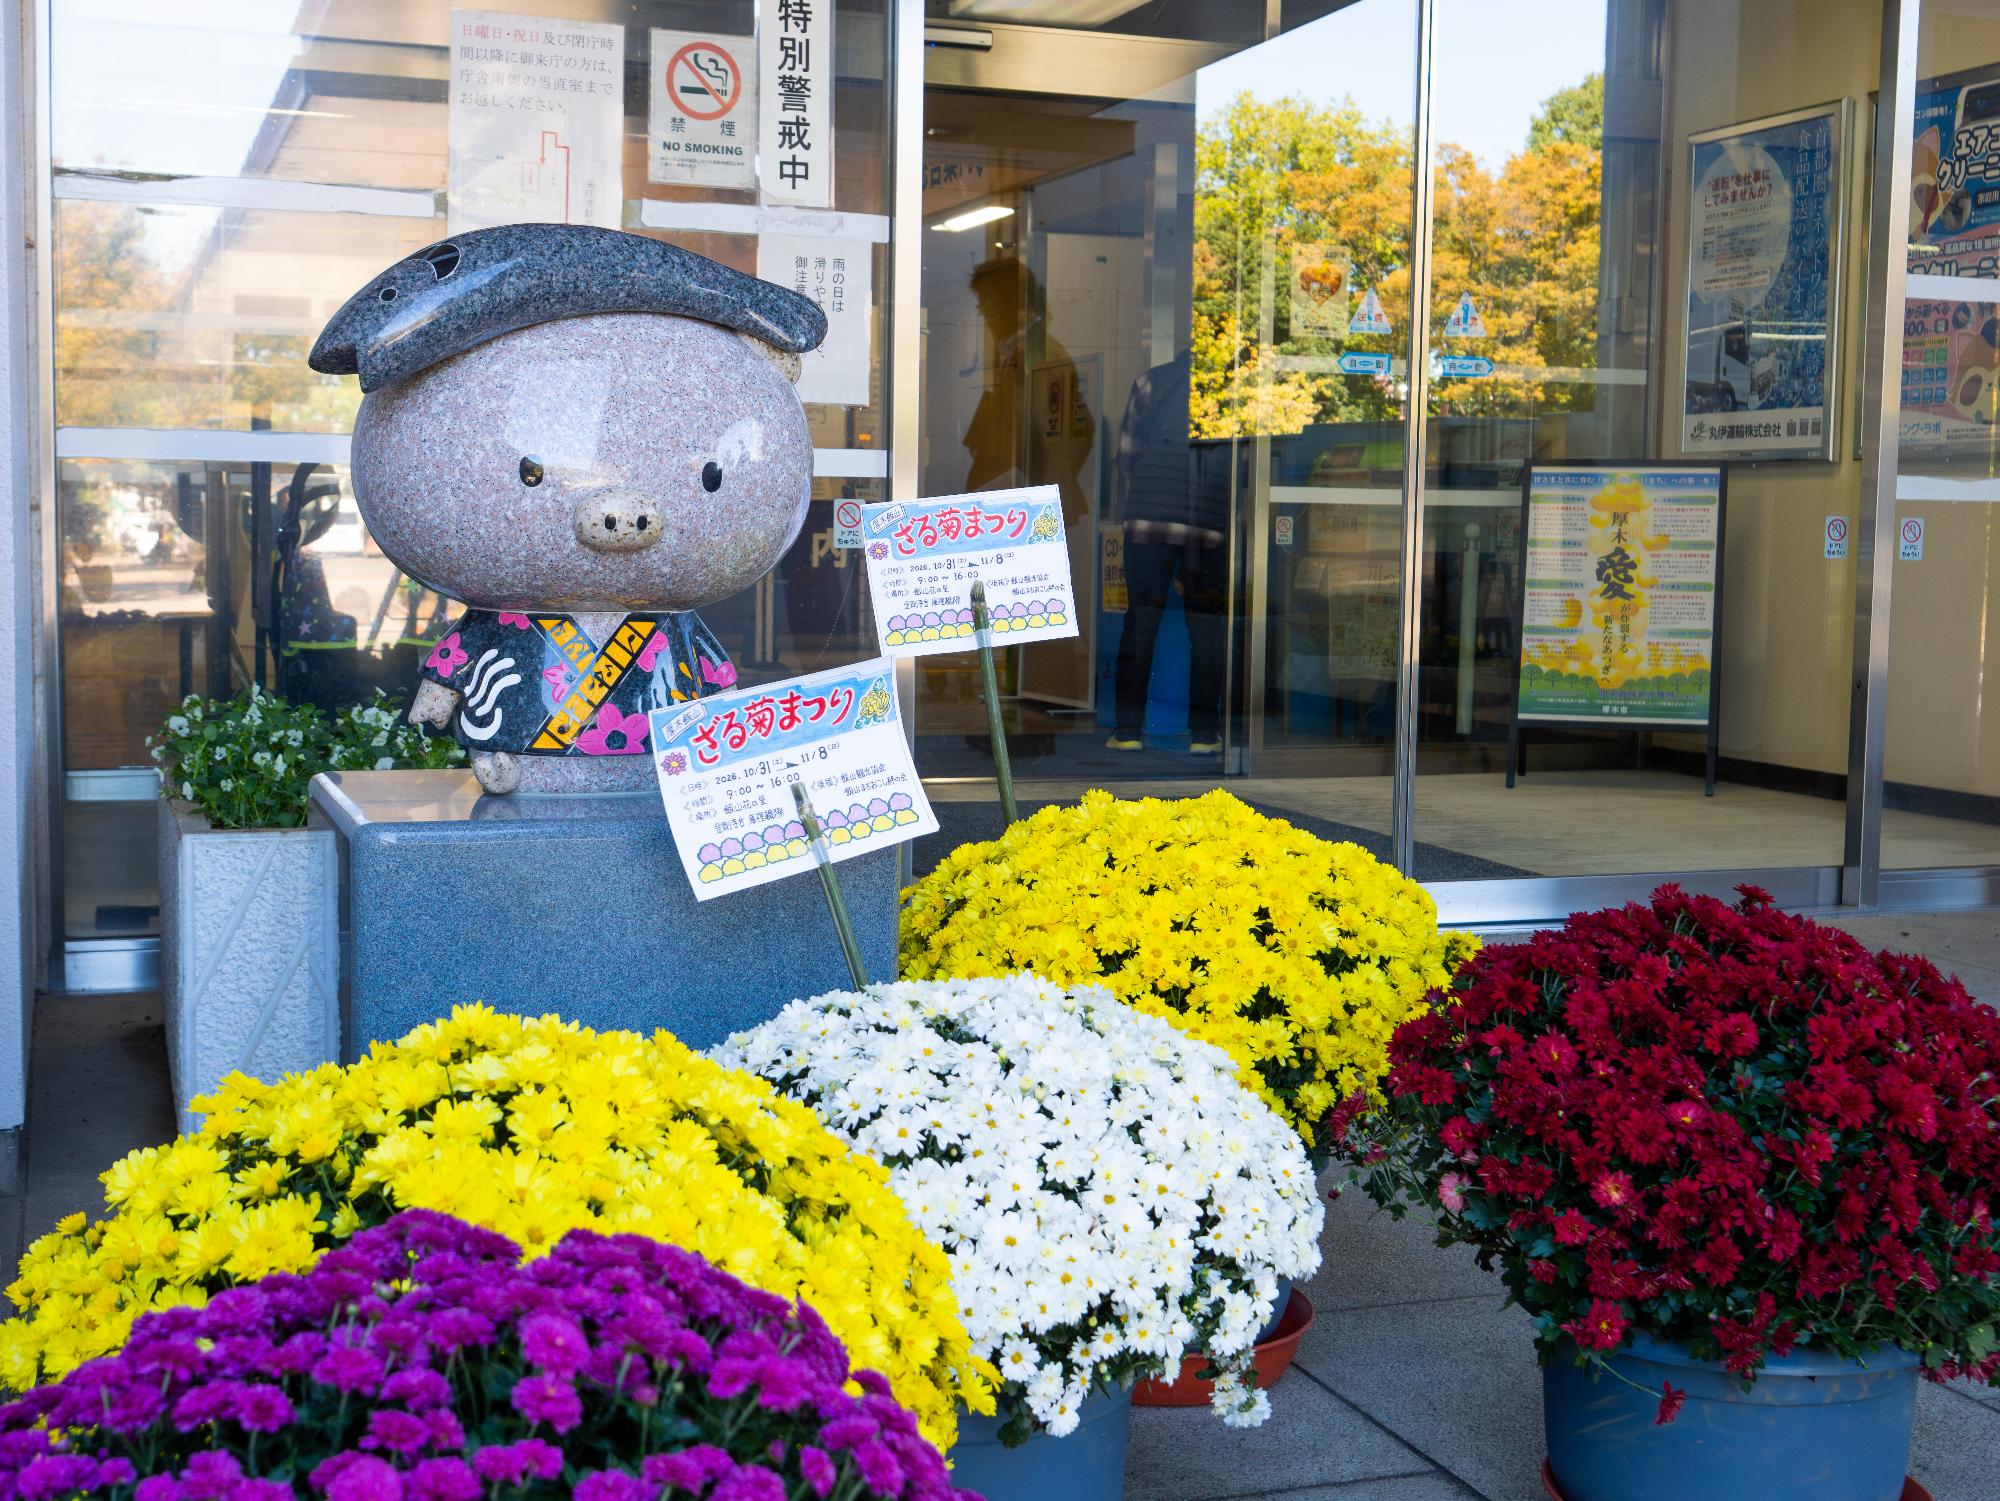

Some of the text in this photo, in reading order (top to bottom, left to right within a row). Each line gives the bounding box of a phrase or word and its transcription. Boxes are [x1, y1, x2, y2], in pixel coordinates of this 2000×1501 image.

[462, 24, 614, 51] 日曜日・祝日及び閉庁時
[460, 46, 613, 74] 間以降に御来庁の方は、
[458, 68, 614, 95] 庁舎南側の当直室まで
[778, 0, 812, 190] 特別警戒中
[459, 91, 568, 114] お越しください。
[662, 141, 743, 156] NO SMOKING
[832, 257, 846, 313] 雨の日は
[814, 256, 826, 359] 滑りやで、
[1709, 422, 1782, 440] 丸伊運輸株式会社
[841, 529, 860, 537] ドアに
[894, 504, 1028, 555] ざる菊まつり
[1611, 511, 1629, 544] 厚木
[812, 527, 847, 568] 内
[1596, 545, 1638, 601] 愛
[665, 709, 701, 737] 厚木飯山
[1602, 705, 1628, 714] 厚木市
[691, 687, 854, 764] ざる菊まつり
[726, 785, 752, 800] 9:00
[770, 772, 800, 789] 16:00
